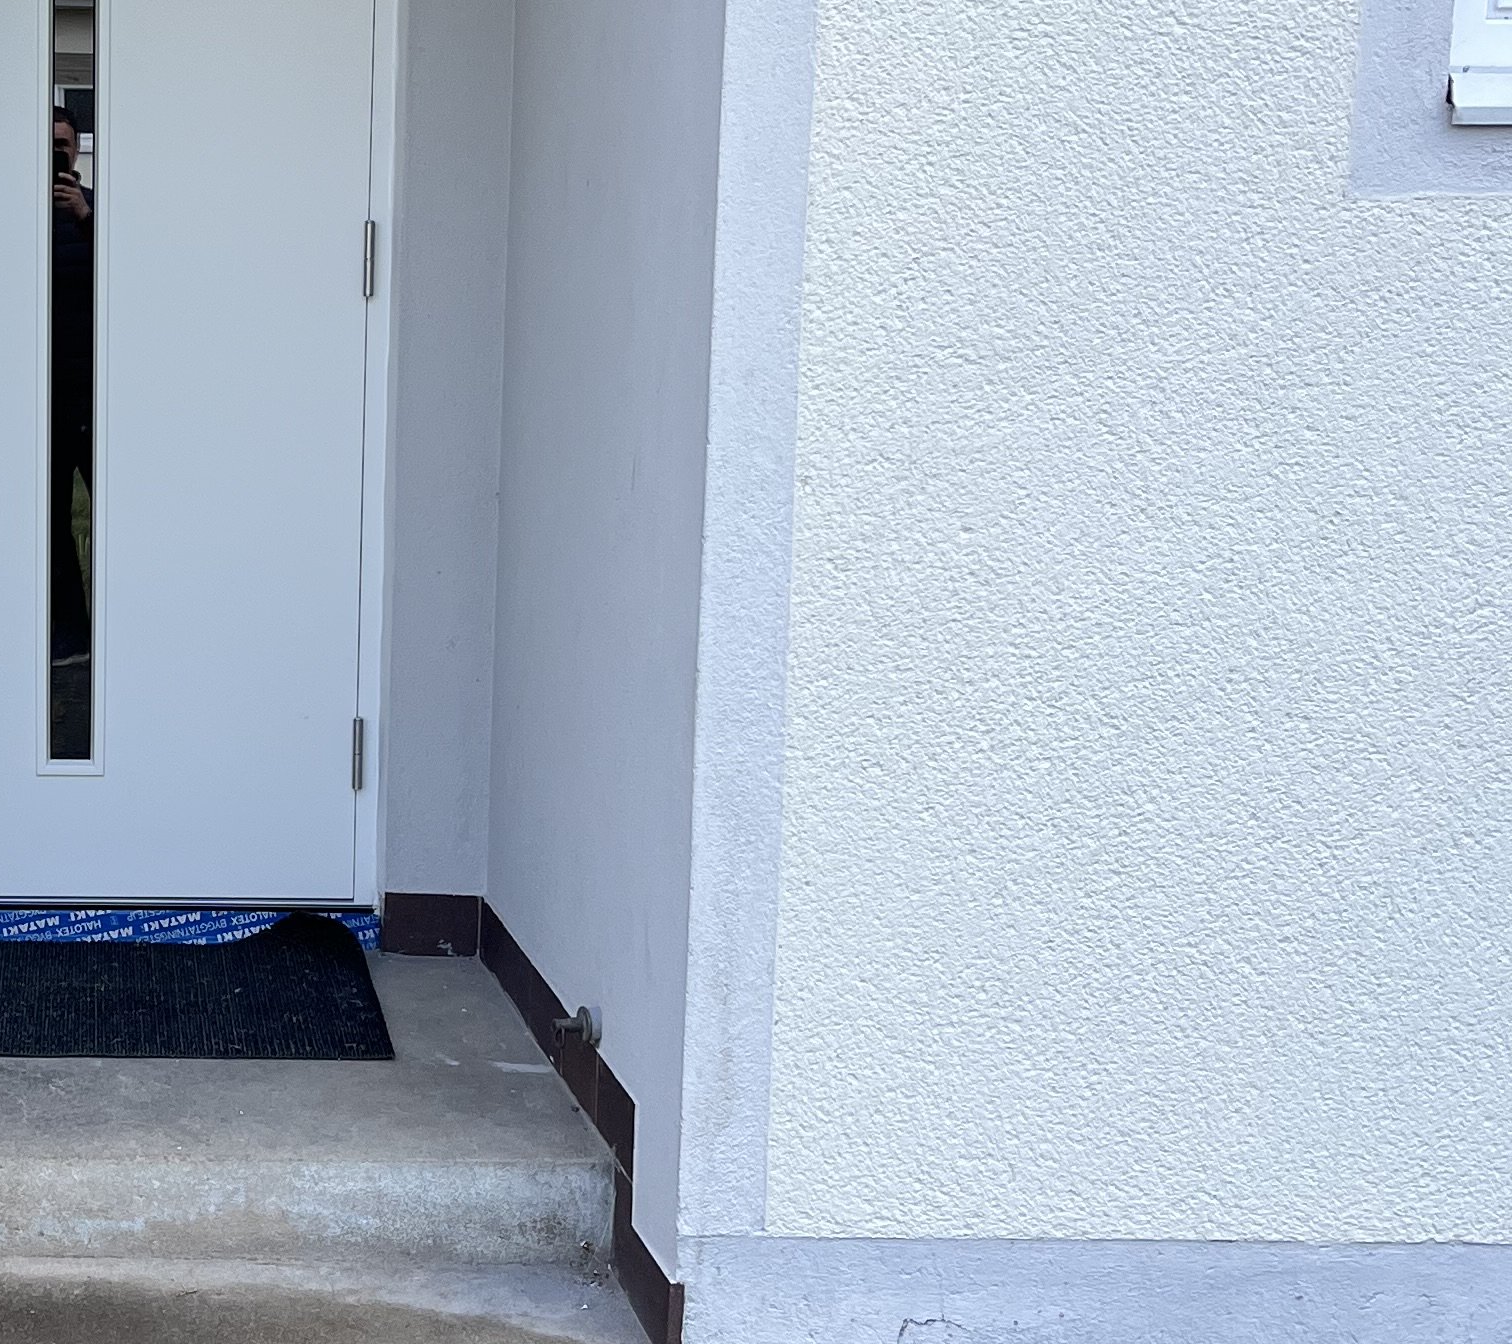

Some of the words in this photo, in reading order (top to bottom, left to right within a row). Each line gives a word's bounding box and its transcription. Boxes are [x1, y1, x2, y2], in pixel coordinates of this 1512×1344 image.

[2, 916, 60, 937] MATAKI
[56, 920, 102, 937] HALOTEX
[143, 911, 201, 933] MATAKI
